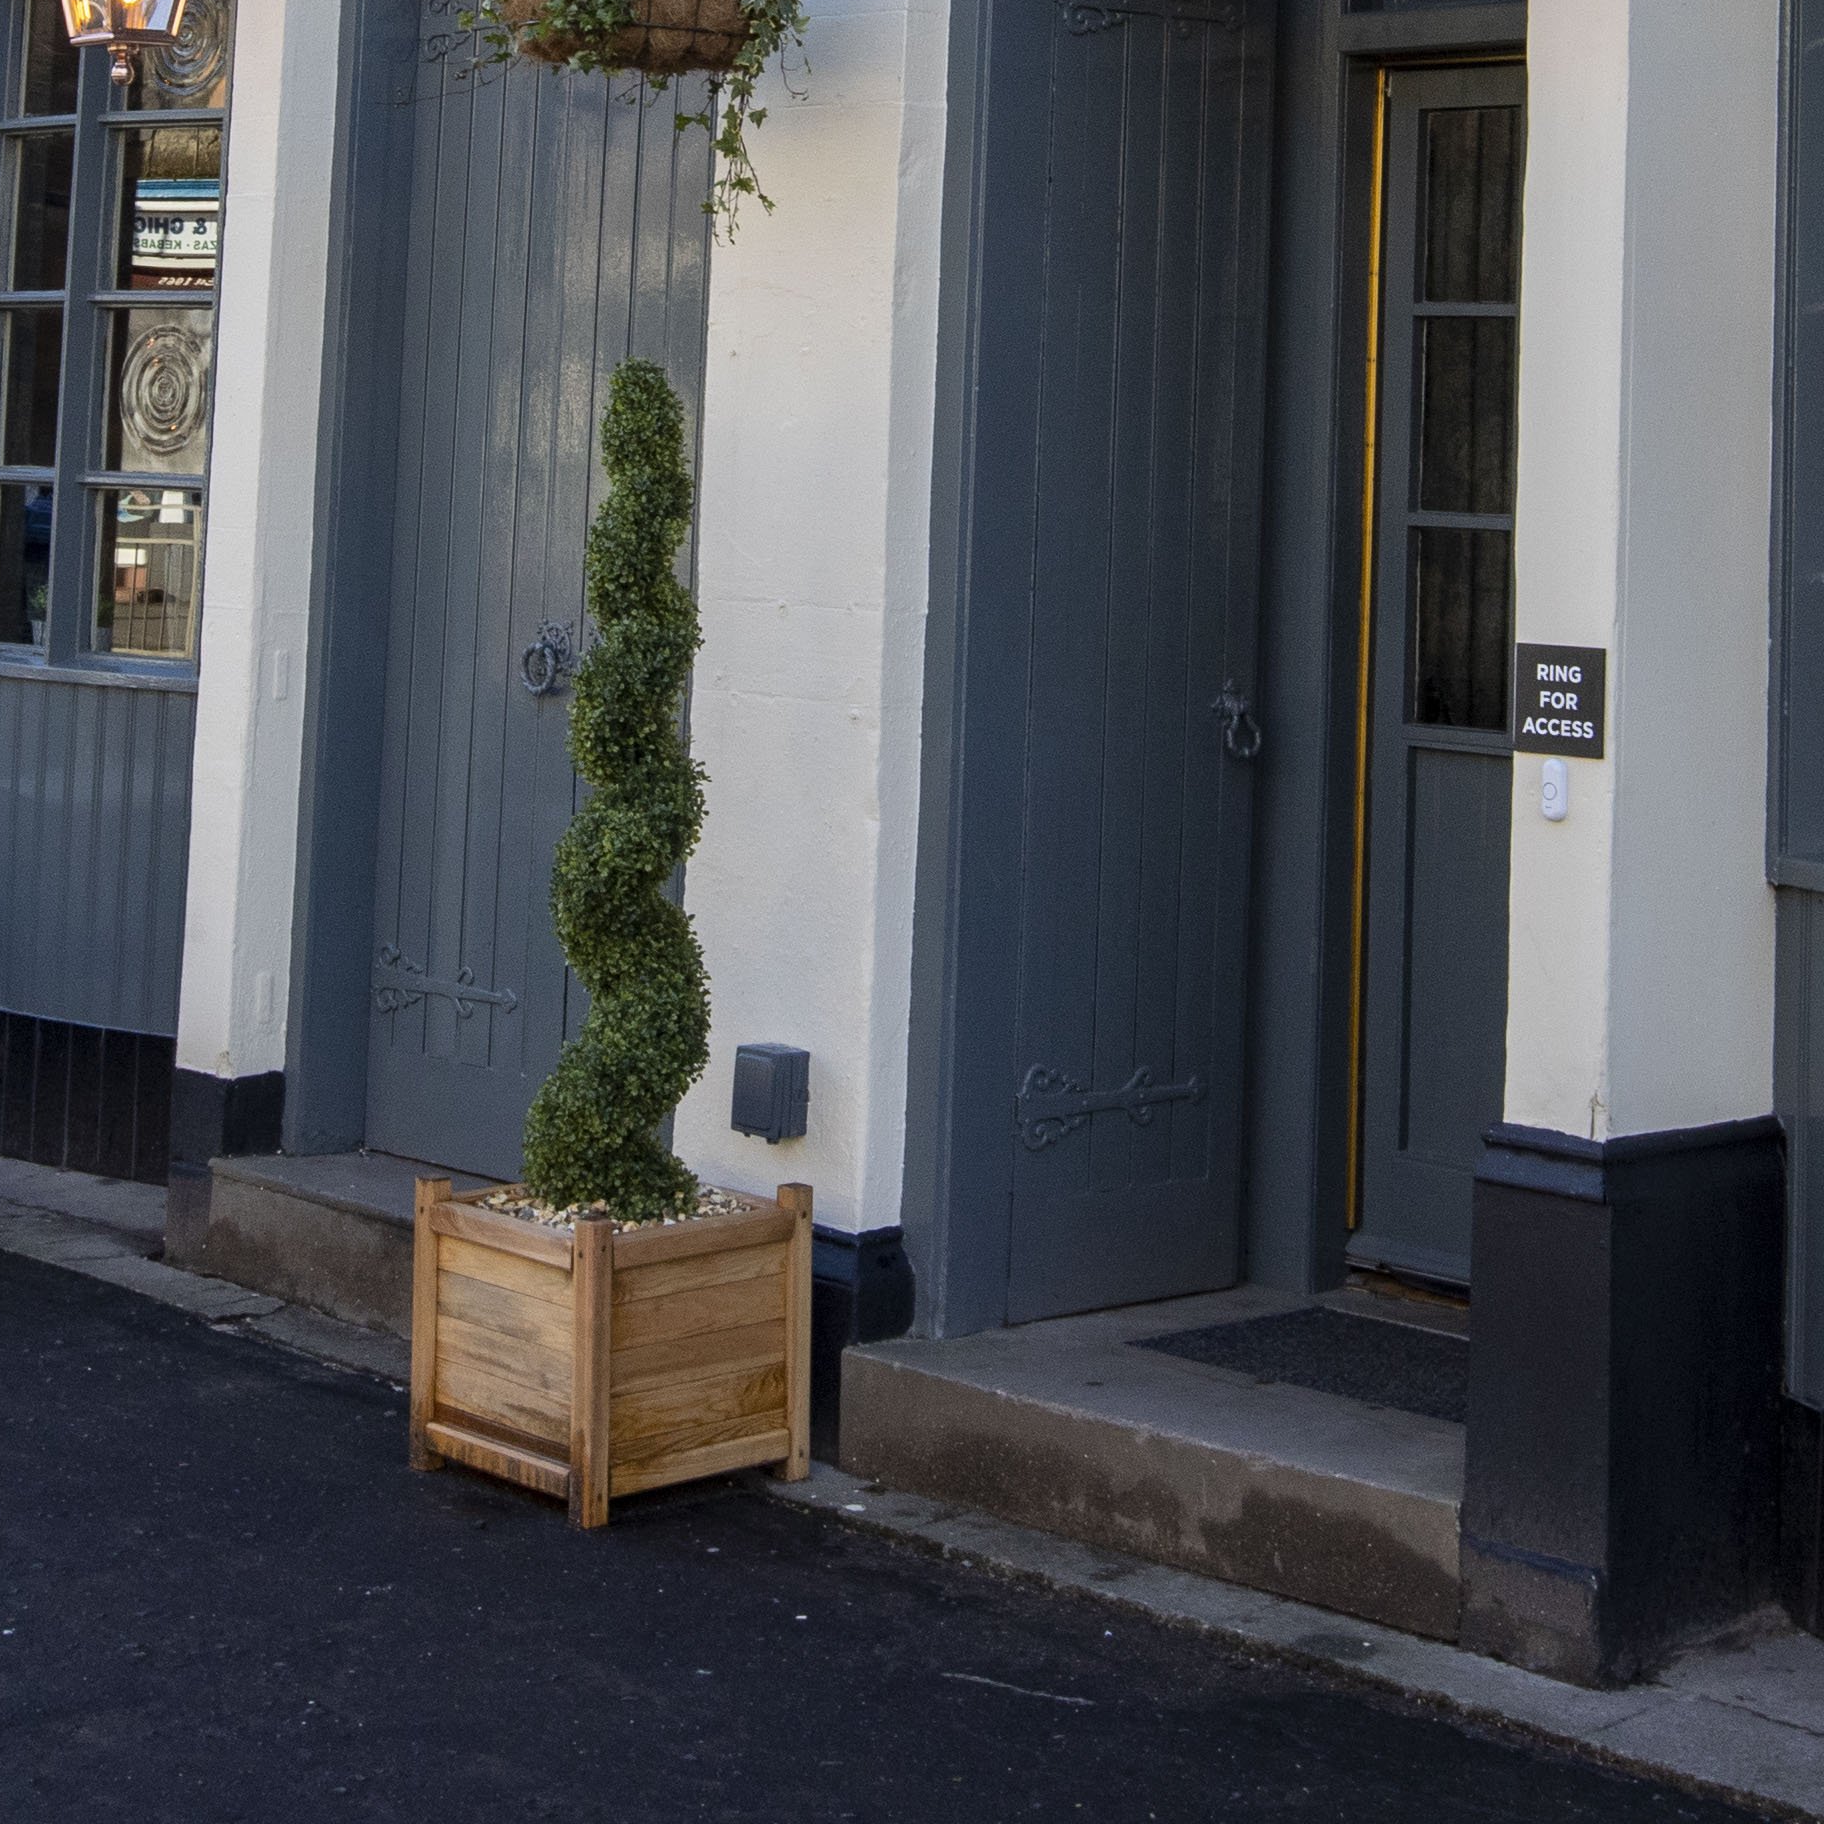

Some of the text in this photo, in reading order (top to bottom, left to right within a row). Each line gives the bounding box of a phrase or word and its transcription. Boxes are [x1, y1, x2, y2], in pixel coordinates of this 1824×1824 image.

[1537, 663, 1582, 683] RING
[1539, 690, 1578, 710] FOR
[1522, 716, 1594, 739] ACCESS
